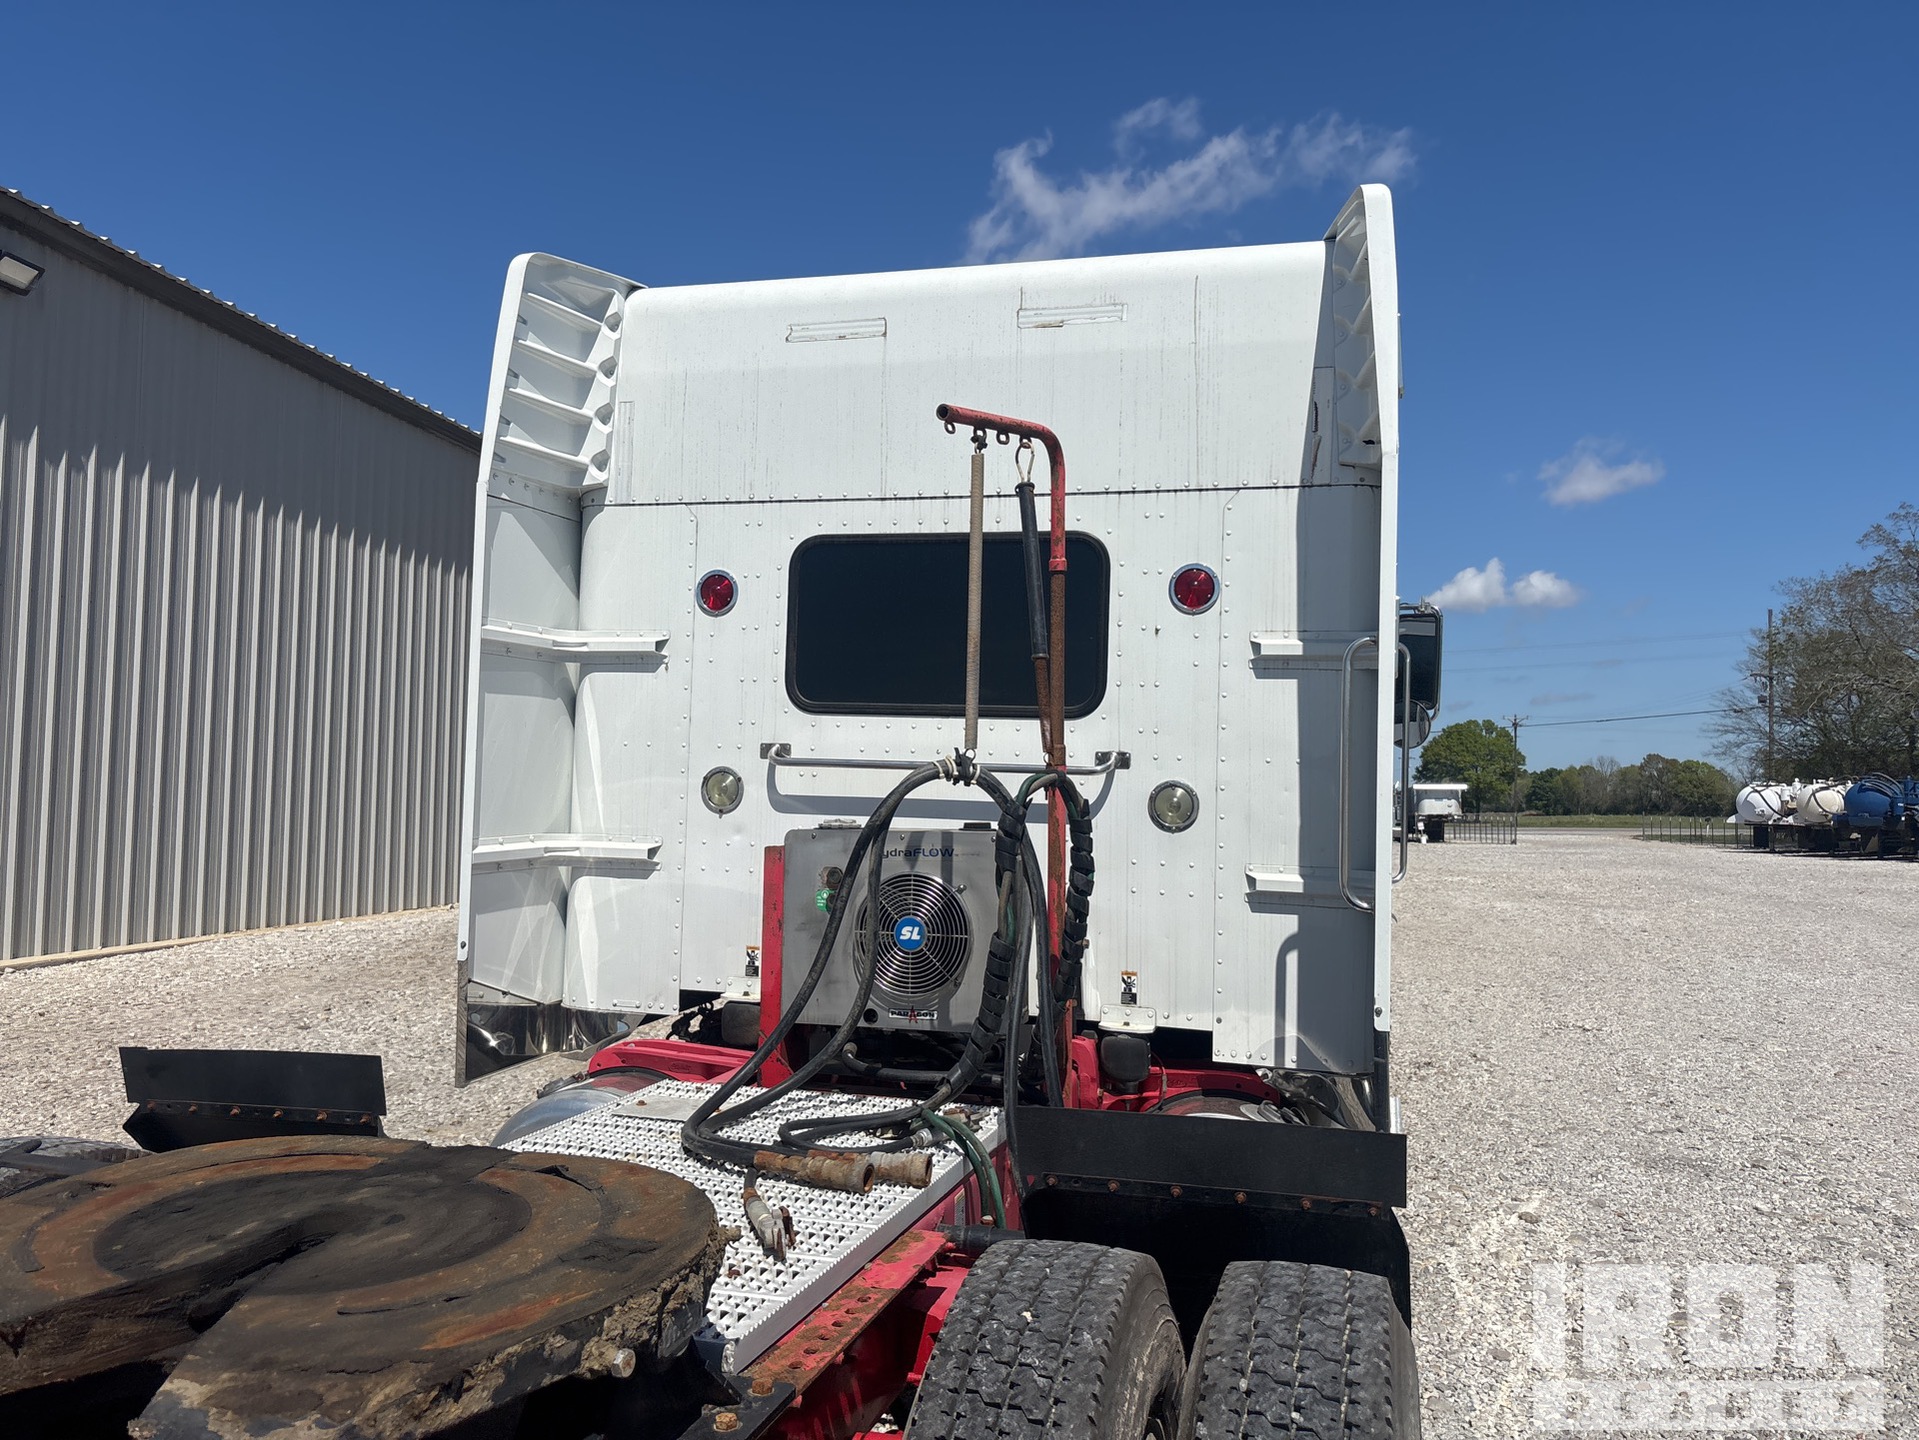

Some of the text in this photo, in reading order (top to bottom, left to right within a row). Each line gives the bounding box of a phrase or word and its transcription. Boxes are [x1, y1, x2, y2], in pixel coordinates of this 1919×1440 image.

[883, 847, 955, 859] ydraFLOW
[900, 926, 921, 940] SL
[890, 1005, 936, 1023] PARAGON
